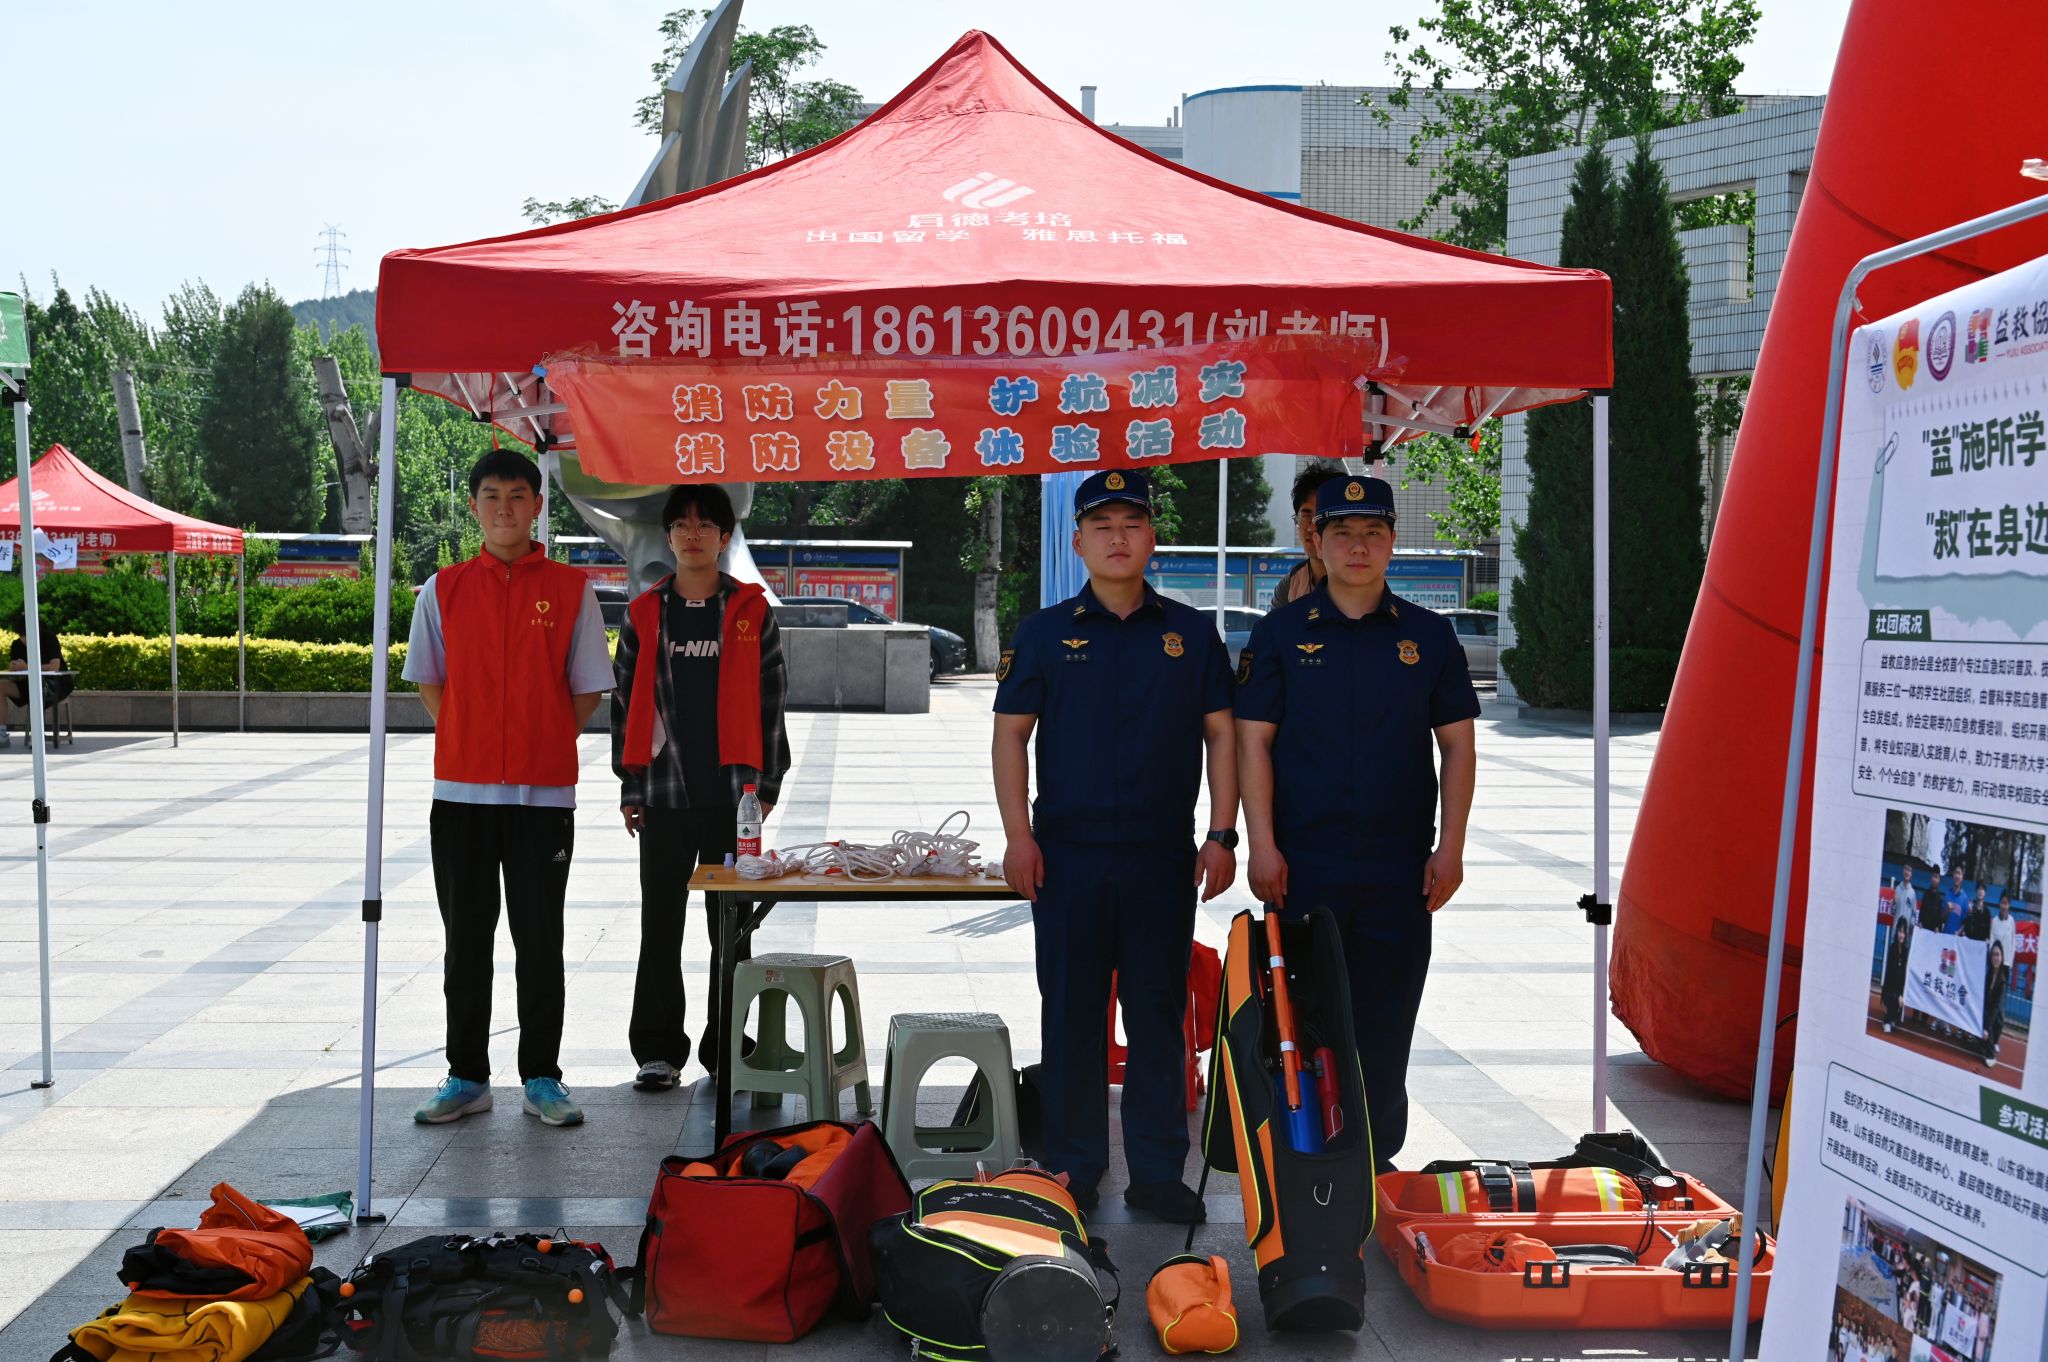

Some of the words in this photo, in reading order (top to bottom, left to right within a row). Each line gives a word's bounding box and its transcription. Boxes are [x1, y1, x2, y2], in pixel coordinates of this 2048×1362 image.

[907, 212, 1073, 228] 启德考培
[806, 229, 970, 243] 出国留学
[1022, 228, 1188, 246] 雅思托福
[672, 378, 935, 422] 消防力量
[988, 360, 1247, 416] 护航减灾
[675, 408, 1247, 475] 消防设备体验活动
[1875, 614, 1923, 634] 社团概况
[1998, 1104, 2048, 1140] 参观活
